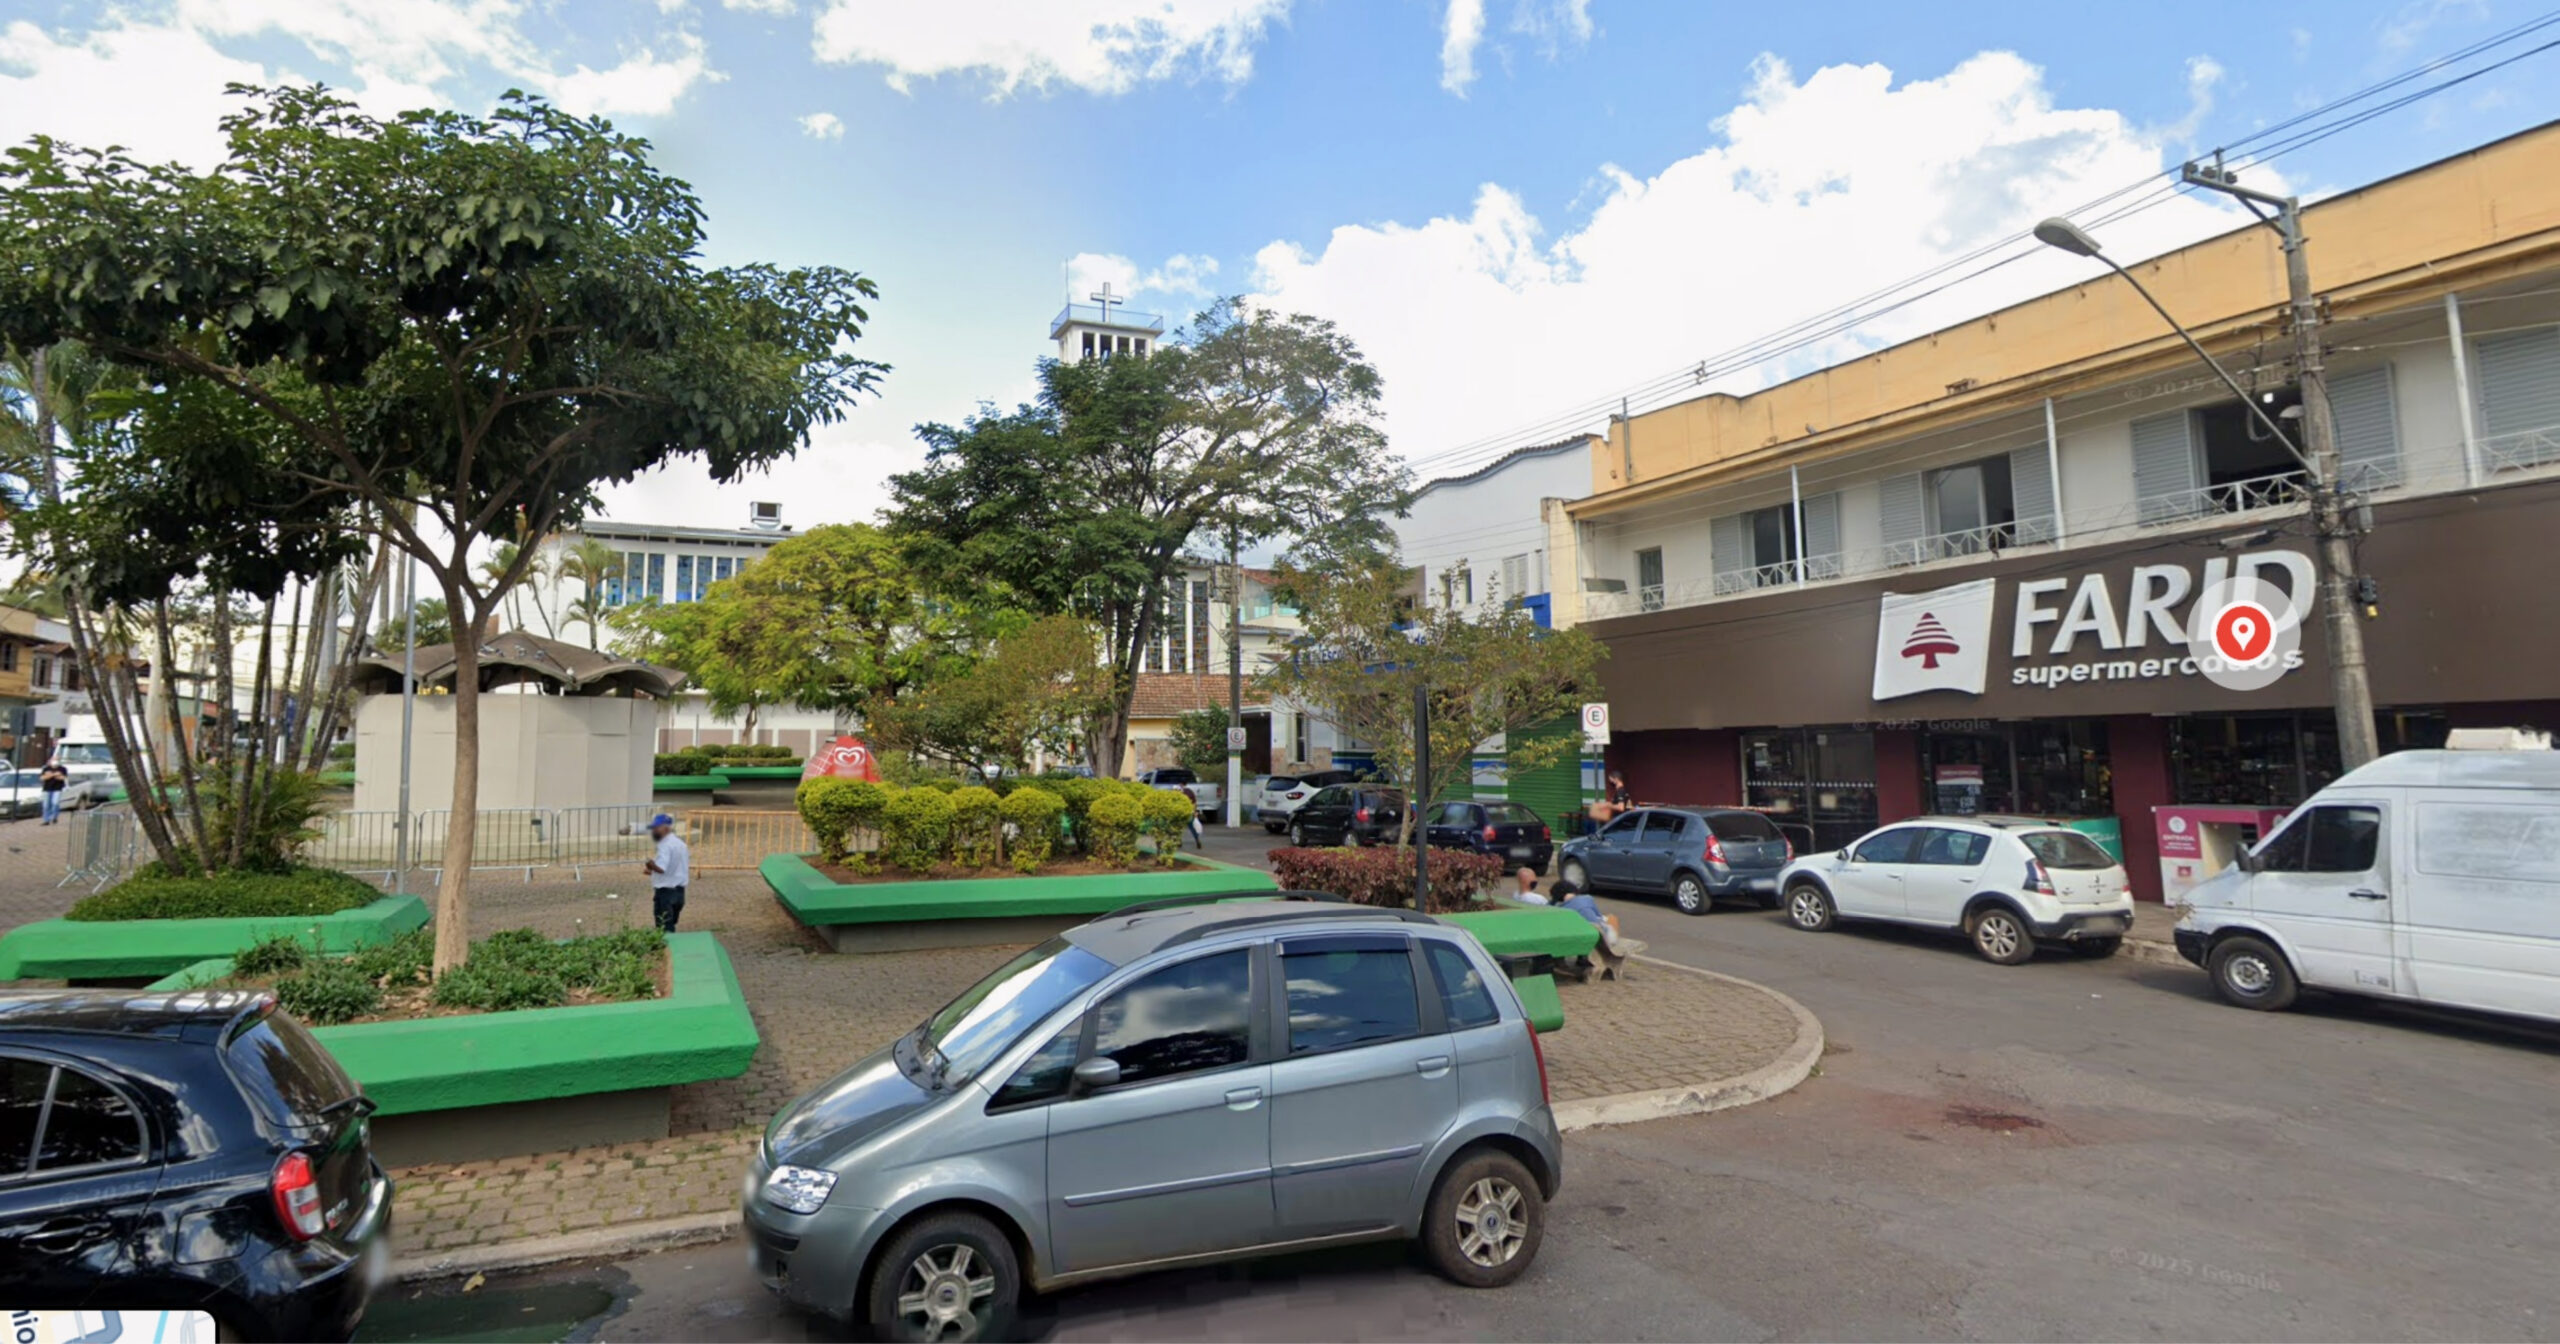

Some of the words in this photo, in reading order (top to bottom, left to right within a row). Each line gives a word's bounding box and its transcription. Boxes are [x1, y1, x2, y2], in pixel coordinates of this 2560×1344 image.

[2012, 549, 2317, 657] FARID
[2012, 649, 2304, 688] supermercaos
[1592, 711, 1600, 721] E
